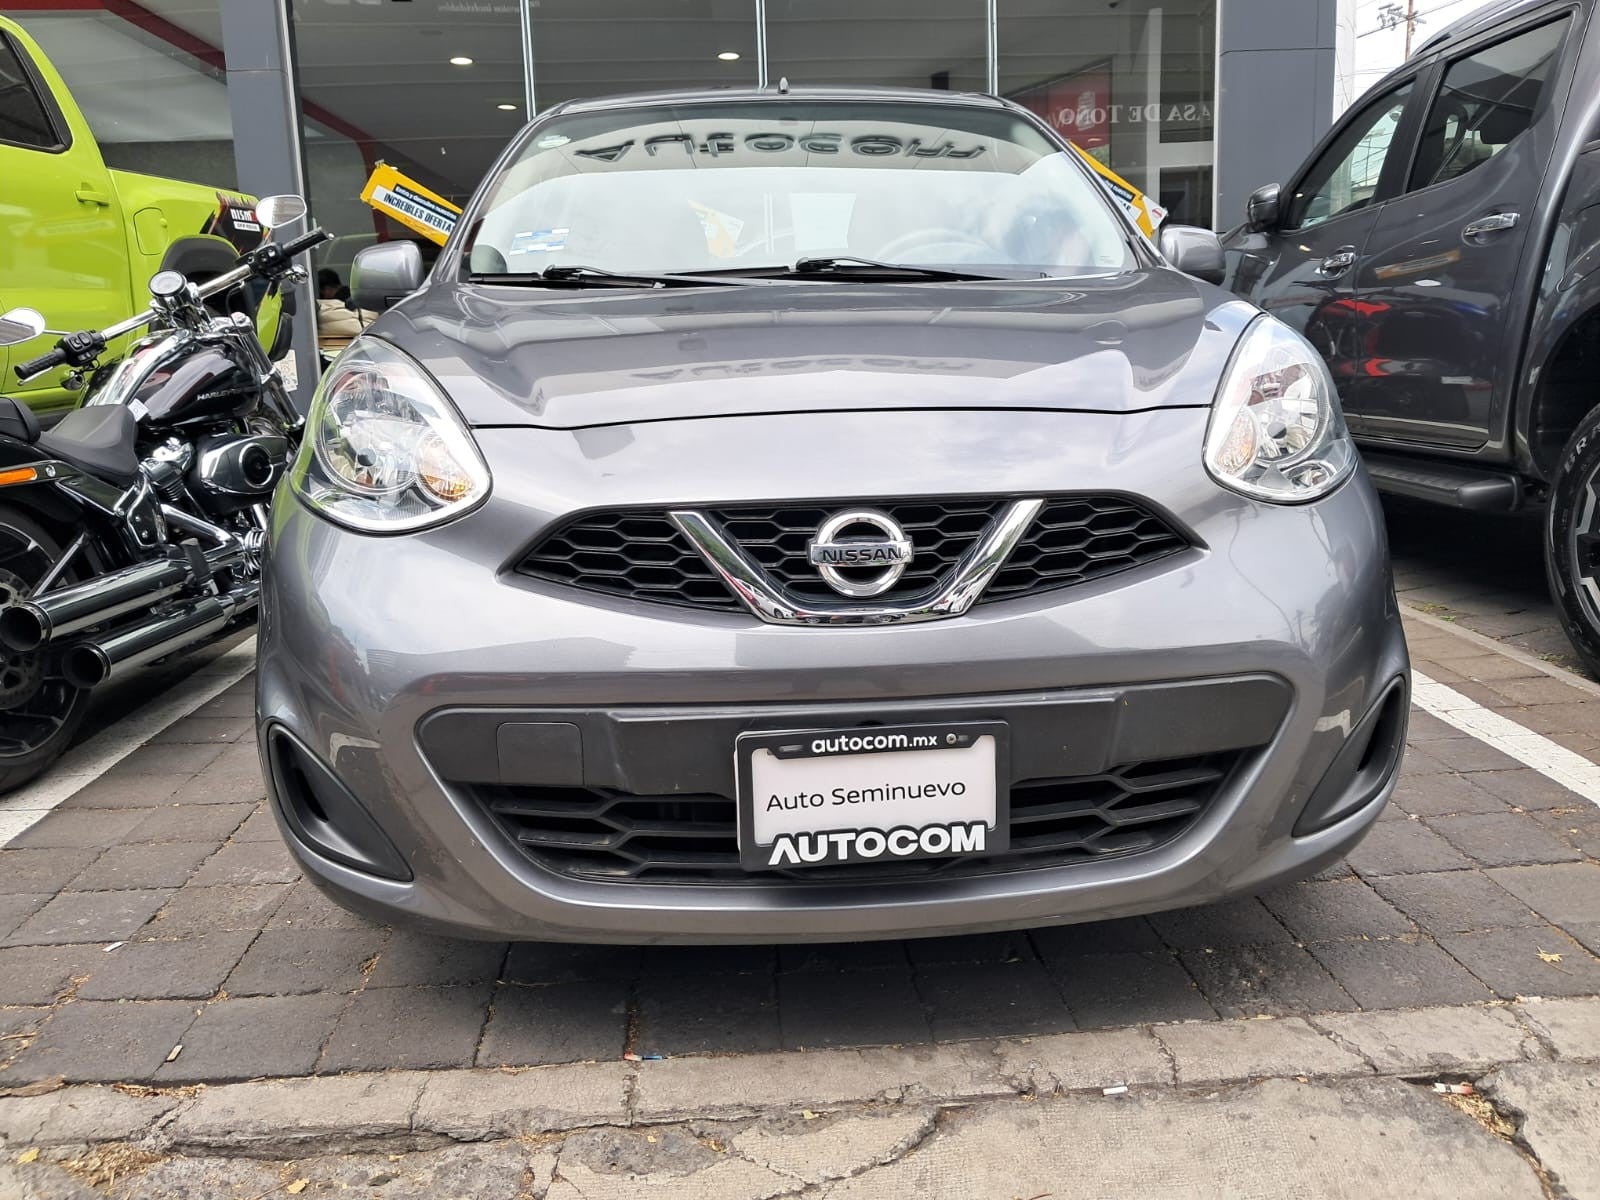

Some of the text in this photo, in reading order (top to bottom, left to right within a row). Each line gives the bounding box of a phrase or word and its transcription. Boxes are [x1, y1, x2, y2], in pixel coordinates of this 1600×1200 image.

[424, 214, 455, 234] OFERTA
[822, 546, 903, 562] NISSAN
[811, 733, 939, 754] autocom.mx
[766, 780, 967, 813] Auto Seminuevo
[767, 823, 986, 866] AUTOCOM
